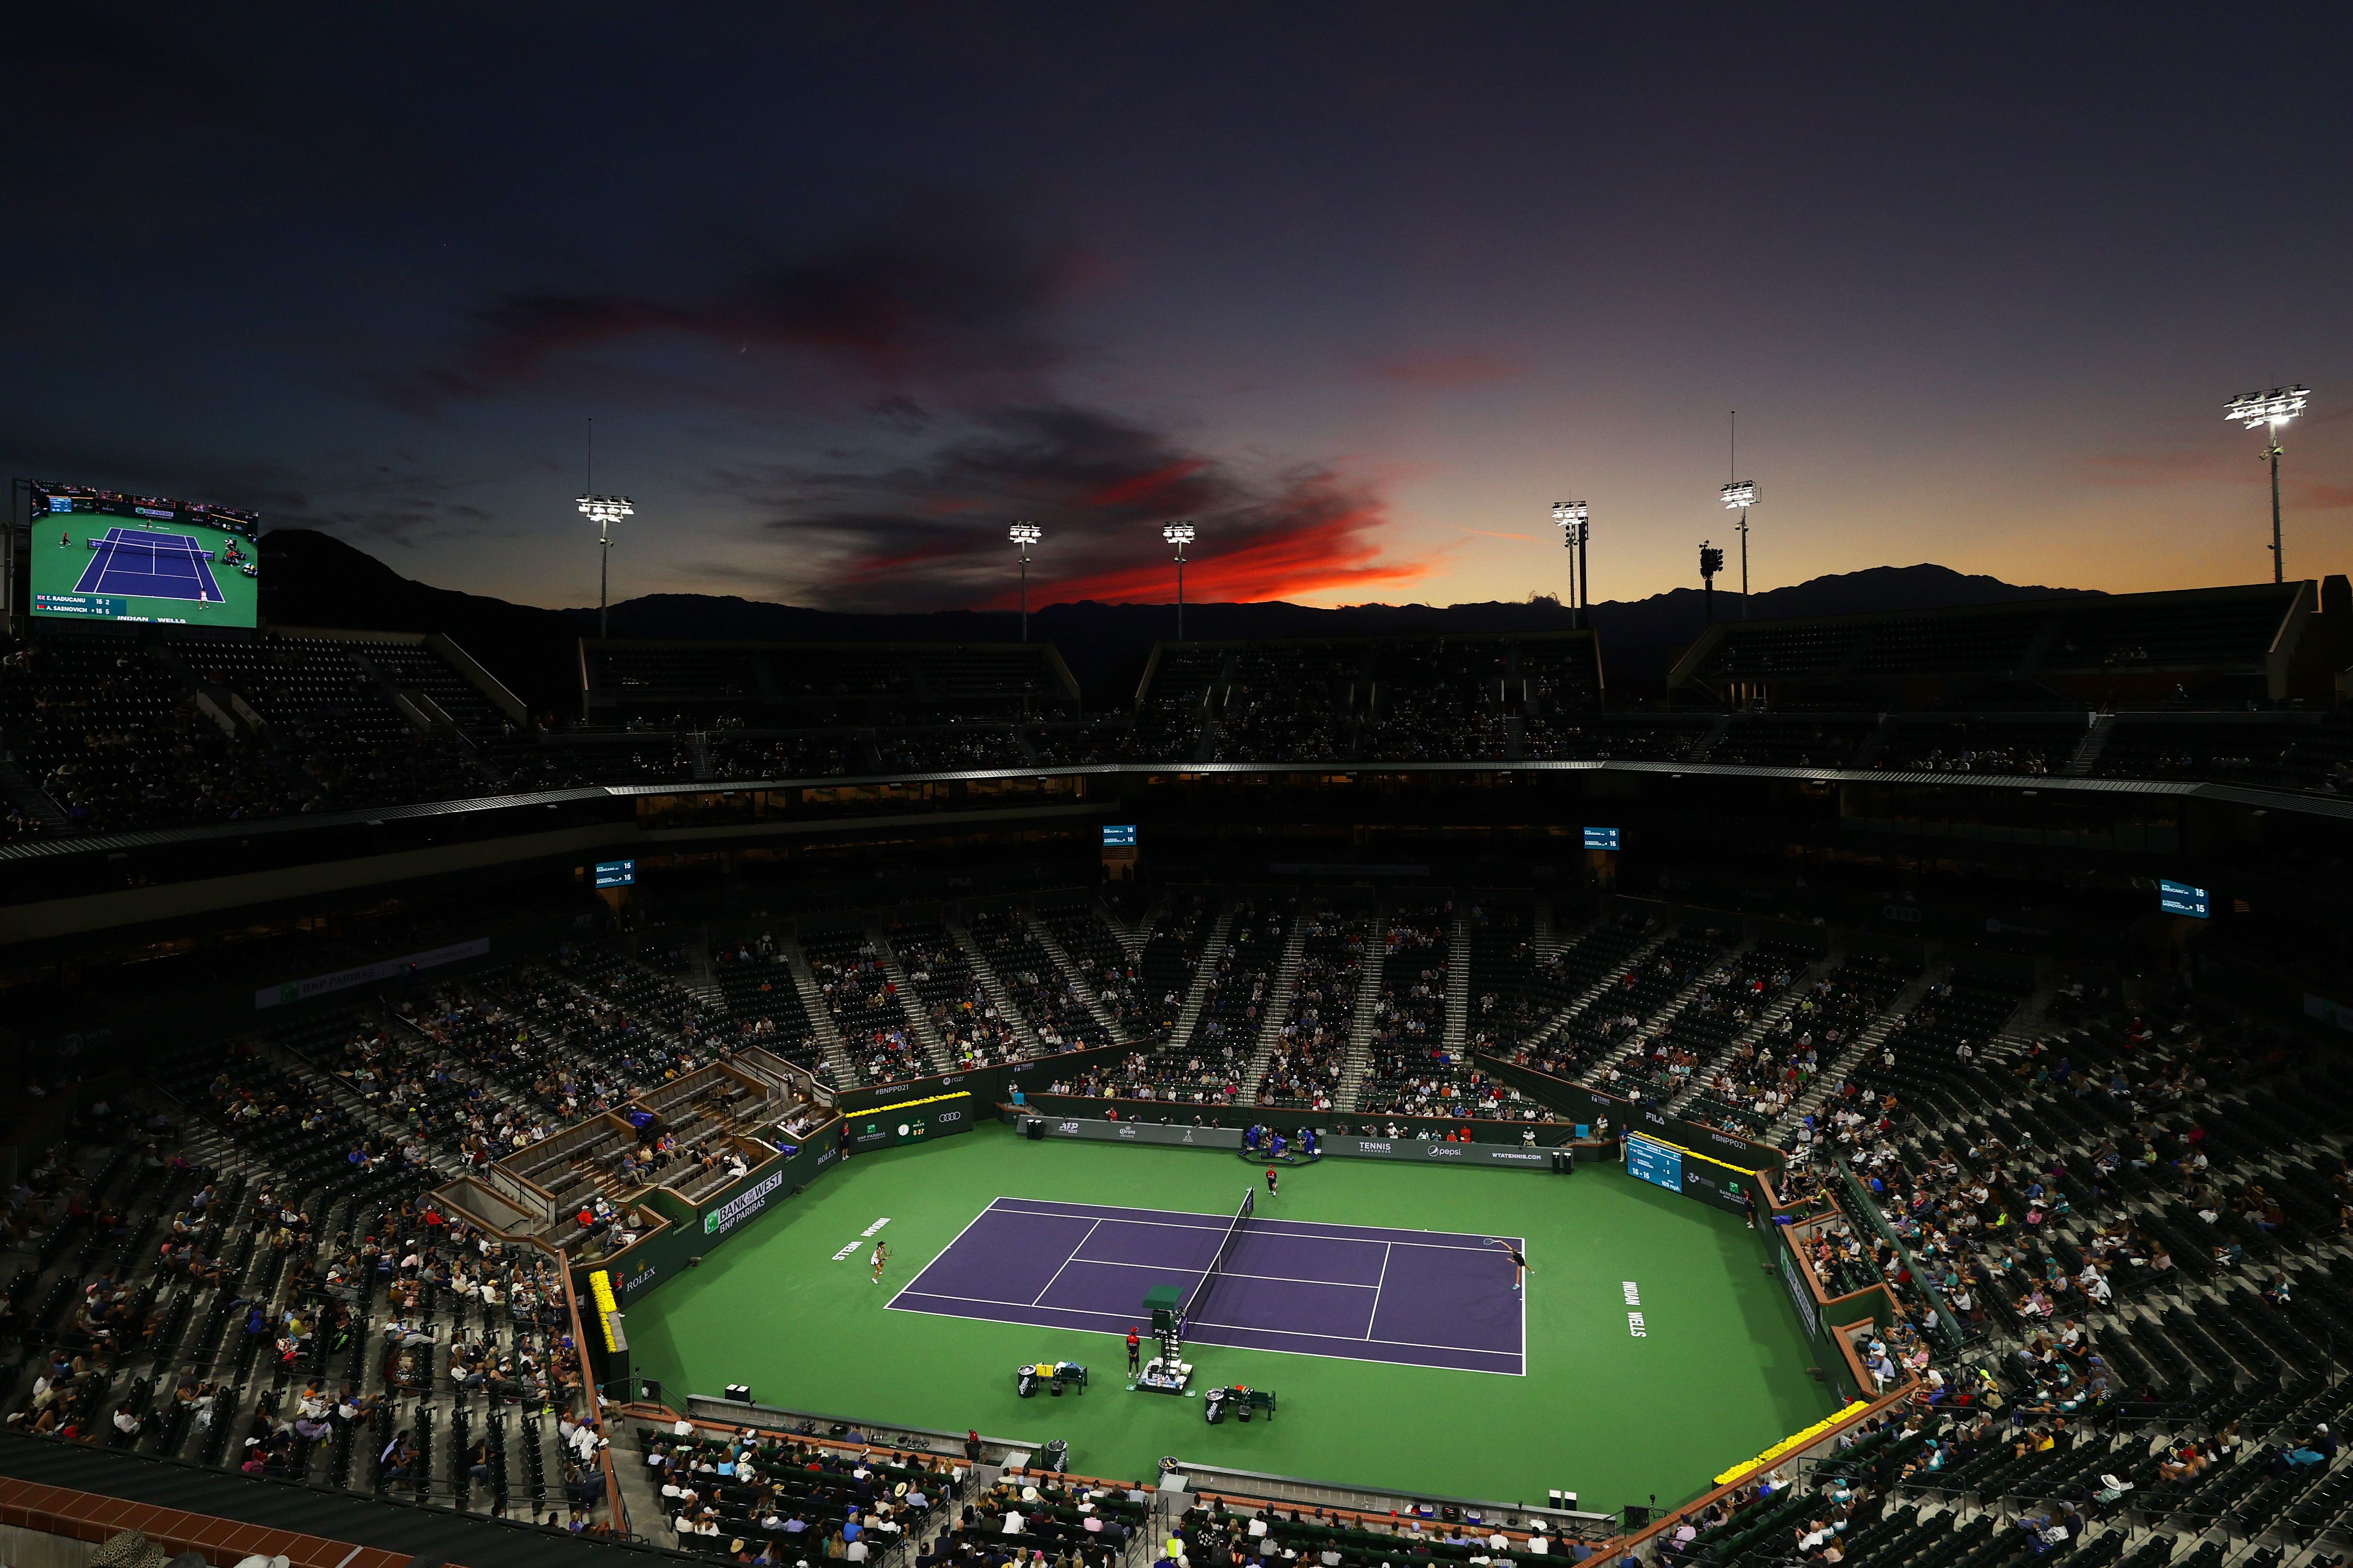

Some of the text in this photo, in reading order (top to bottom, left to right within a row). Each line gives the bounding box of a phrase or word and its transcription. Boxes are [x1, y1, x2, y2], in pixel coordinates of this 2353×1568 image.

[2195, 888, 2204, 897] 15
[2196, 904, 2205, 913] 15
[303, 969, 374, 992] BNP PARIBAS
[1598, 1096, 1610, 1104] TENNIS
[1646, 1112, 1665, 1125] FILA
[818, 1147, 836, 1165] ROLEX
[1359, 1142, 1391, 1151] TENNIS
[720, 1195, 747, 1221] BANK
[747, 1195, 755, 1203] THE
[755, 1172, 780, 1198] WEST
[720, 1197, 765, 1234] BNP PARIBAS
[860, 1218, 891, 1237] INDIAN
[832, 1241, 863, 1261] WELLS
[627, 1266, 656, 1292] ROLEX
[1622, 1281, 1647, 1337] INDIAN WELLS
